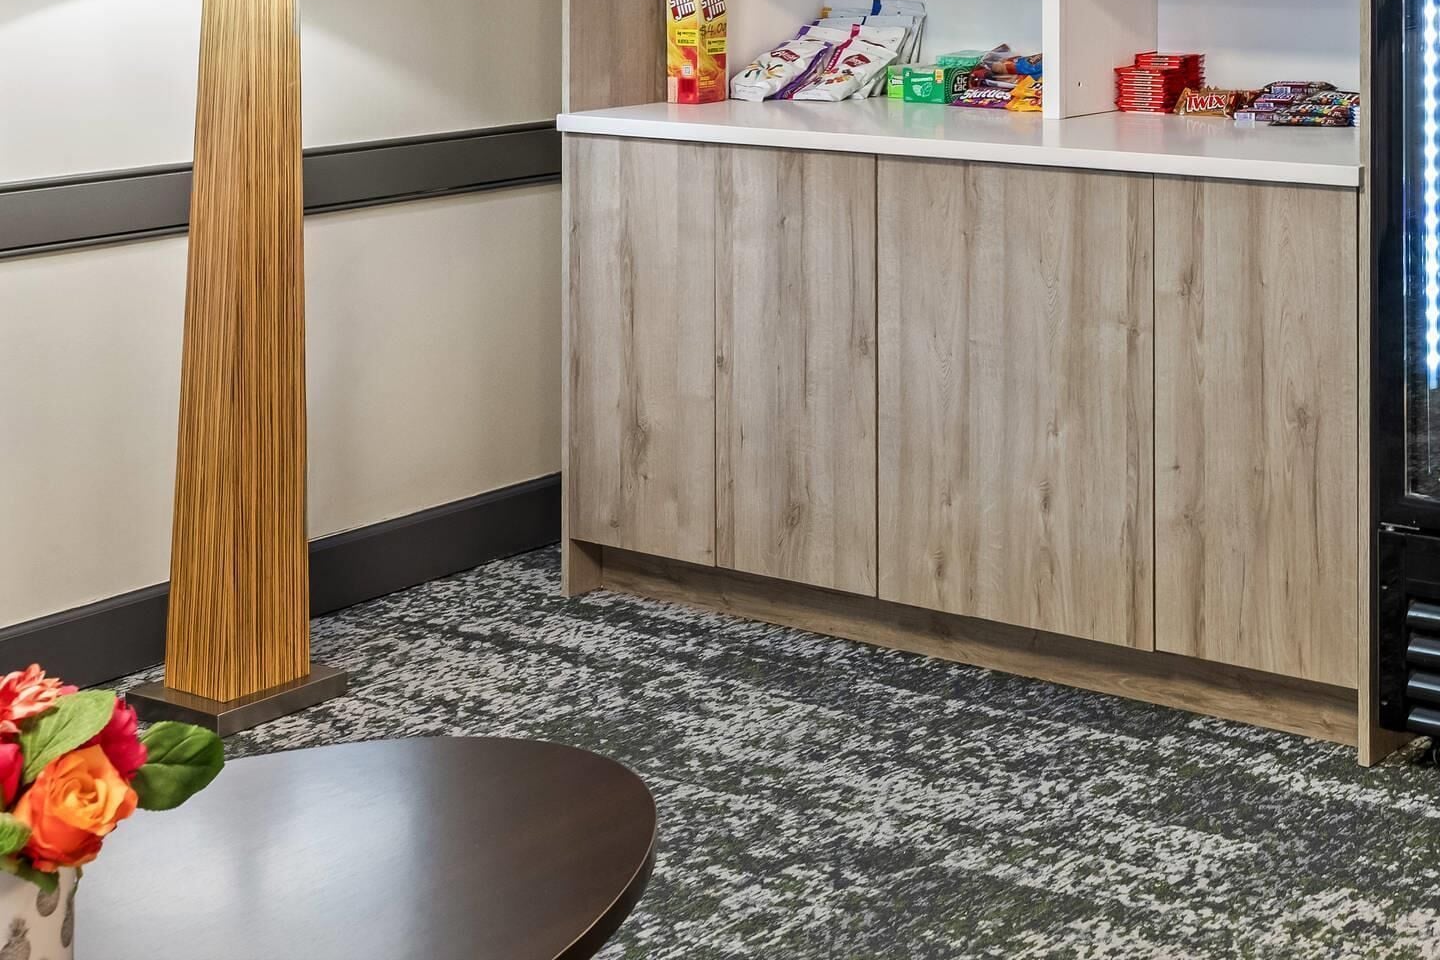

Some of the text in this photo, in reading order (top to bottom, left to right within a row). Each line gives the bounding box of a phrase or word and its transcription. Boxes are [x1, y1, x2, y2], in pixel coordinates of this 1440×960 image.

[956, 74, 969, 84] tic
[954, 83, 968, 92] tac
[959, 88, 1012, 100] Skittles
[1186, 94, 1225, 112] TWIX
